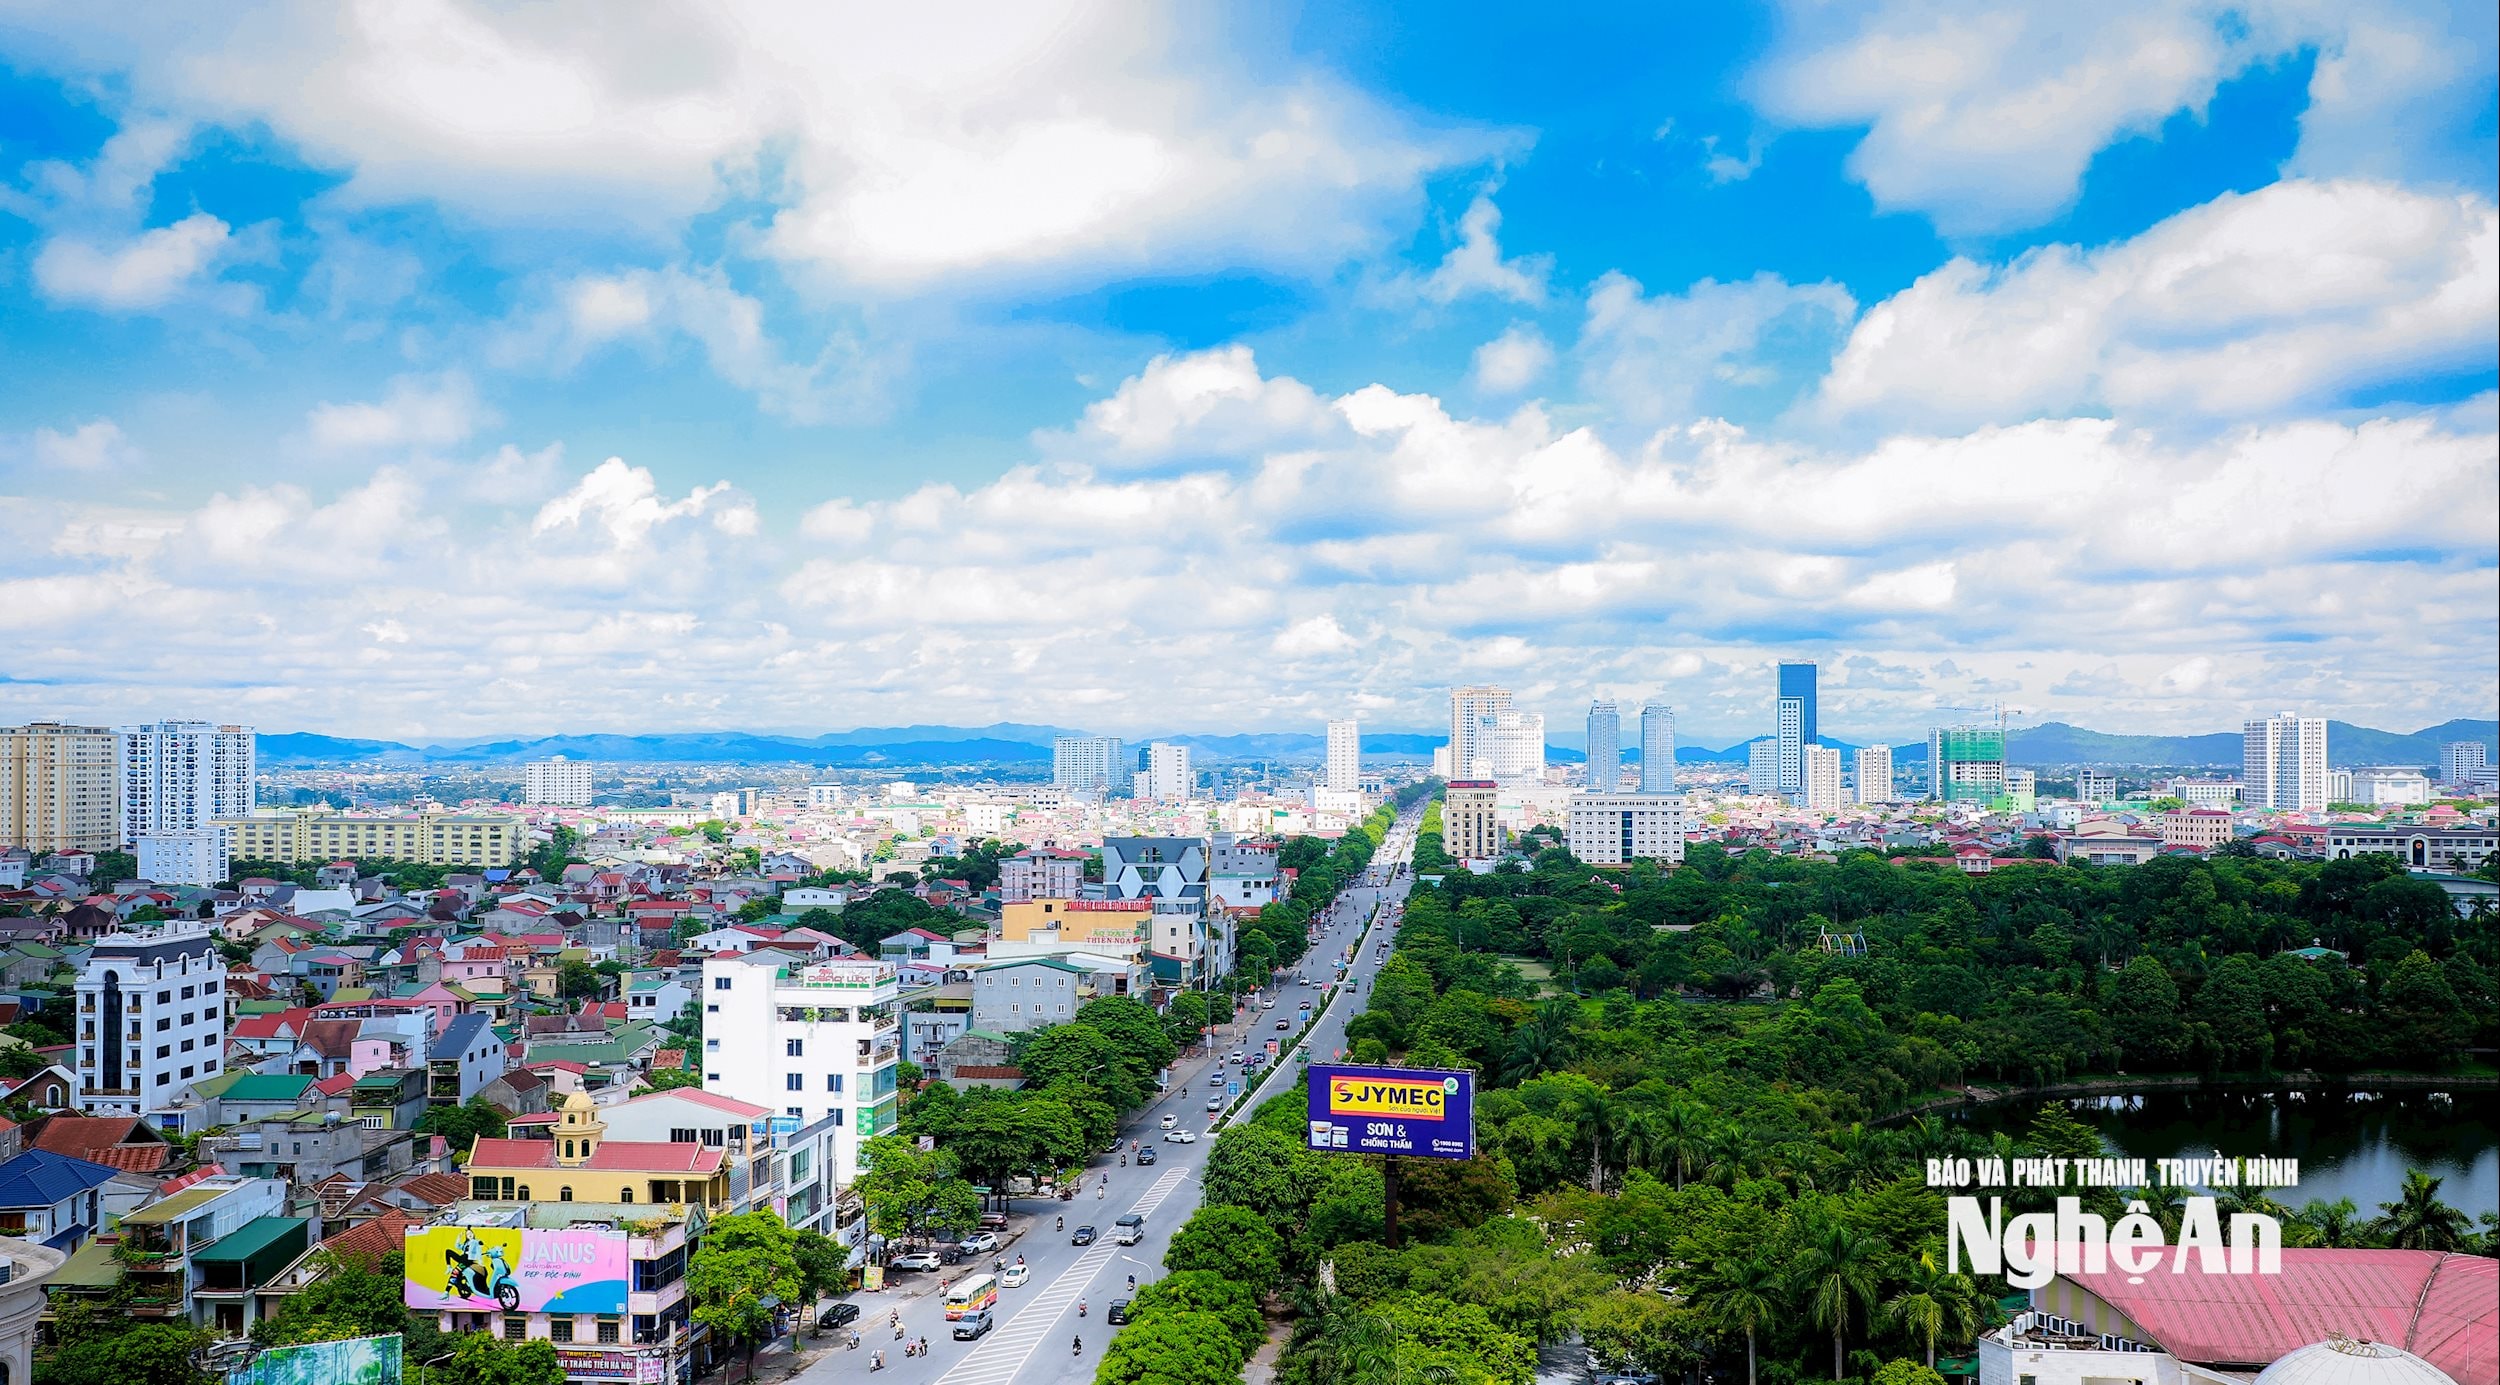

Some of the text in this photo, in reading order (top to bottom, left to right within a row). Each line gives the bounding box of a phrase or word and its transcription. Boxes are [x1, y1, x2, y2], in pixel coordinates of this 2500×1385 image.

[1357, 1086, 1441, 1106] JYMEC
[1367, 1122, 1406, 1137] SƠN &
[1361, 1135, 1412, 1149] CHỐNG THẤM
[523, 1241, 596, 1264] JANUS
[570, 1358, 593, 1369] TRÀNG
[594, 1358, 609, 1369] TIỀN
[611, 1359, 620, 1370] HÀ
[622, 1359, 633, 1372] NỘI
